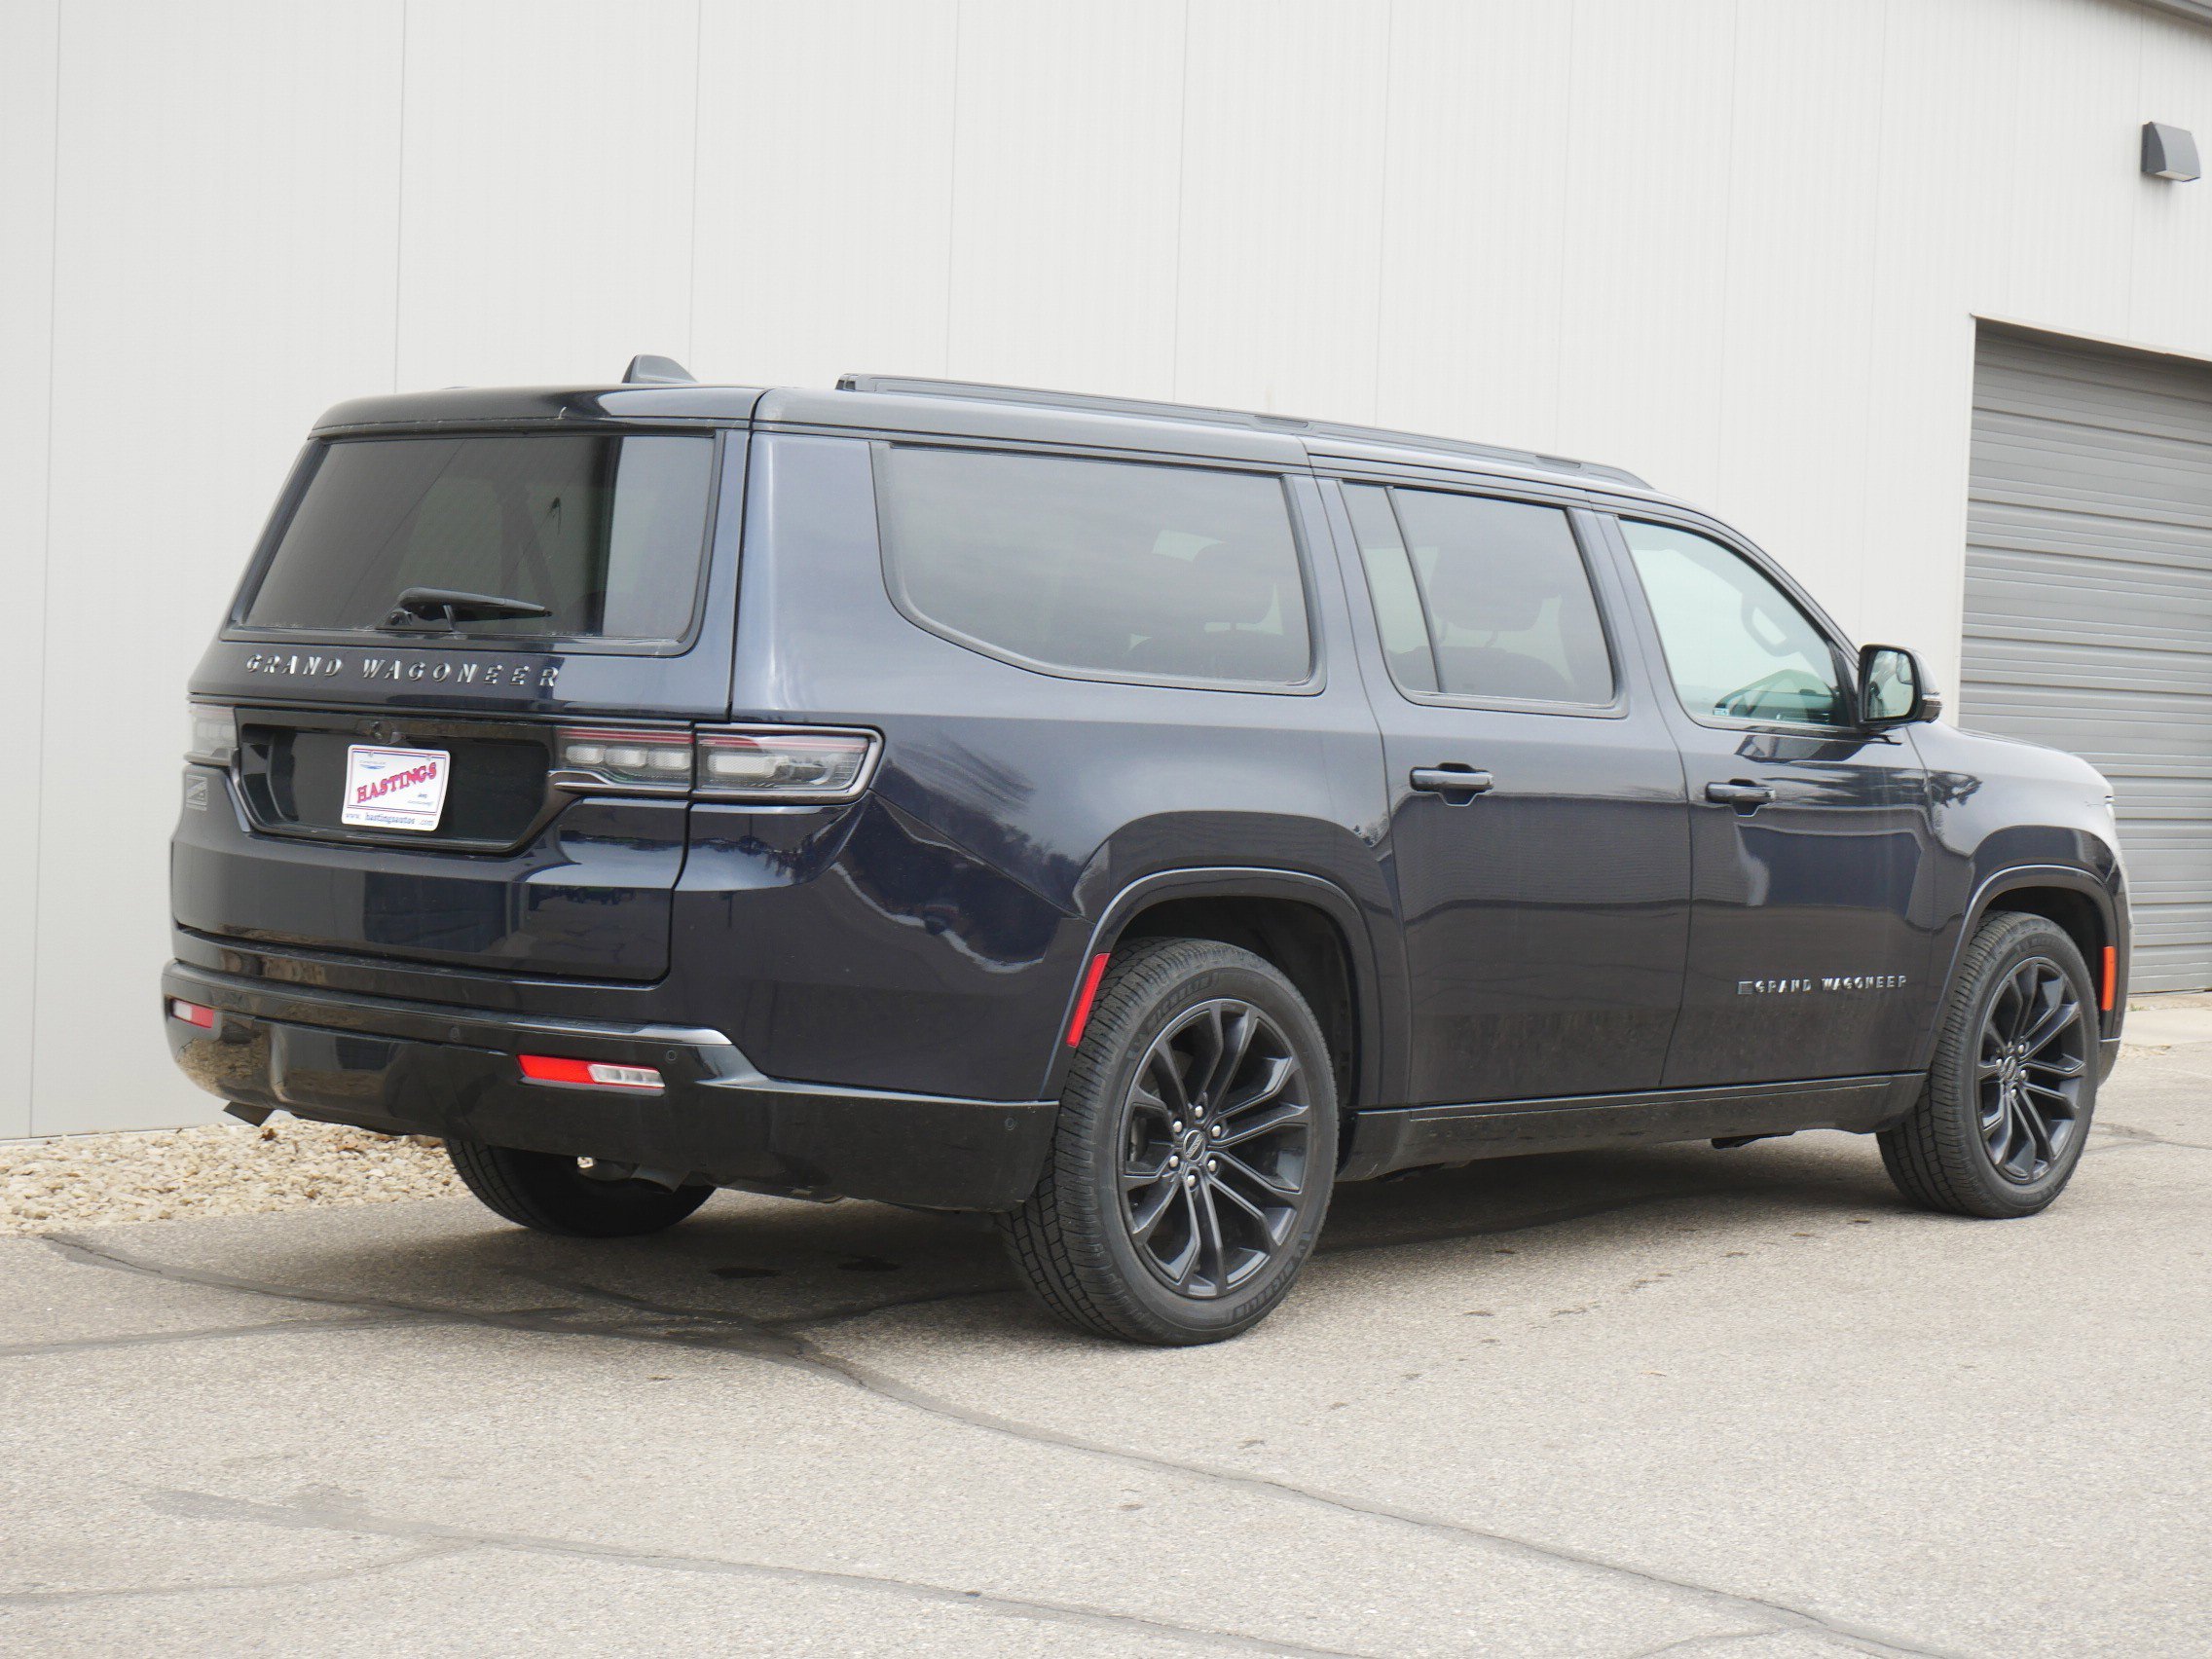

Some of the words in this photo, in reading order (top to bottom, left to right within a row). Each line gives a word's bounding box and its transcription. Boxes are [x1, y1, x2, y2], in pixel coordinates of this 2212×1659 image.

[246, 653, 343, 677] GRAND
[362, 658, 559, 686] WAGONEER
[356, 761, 437, 803] HASTINGS
[1755, 978, 1812, 993] GRAND
